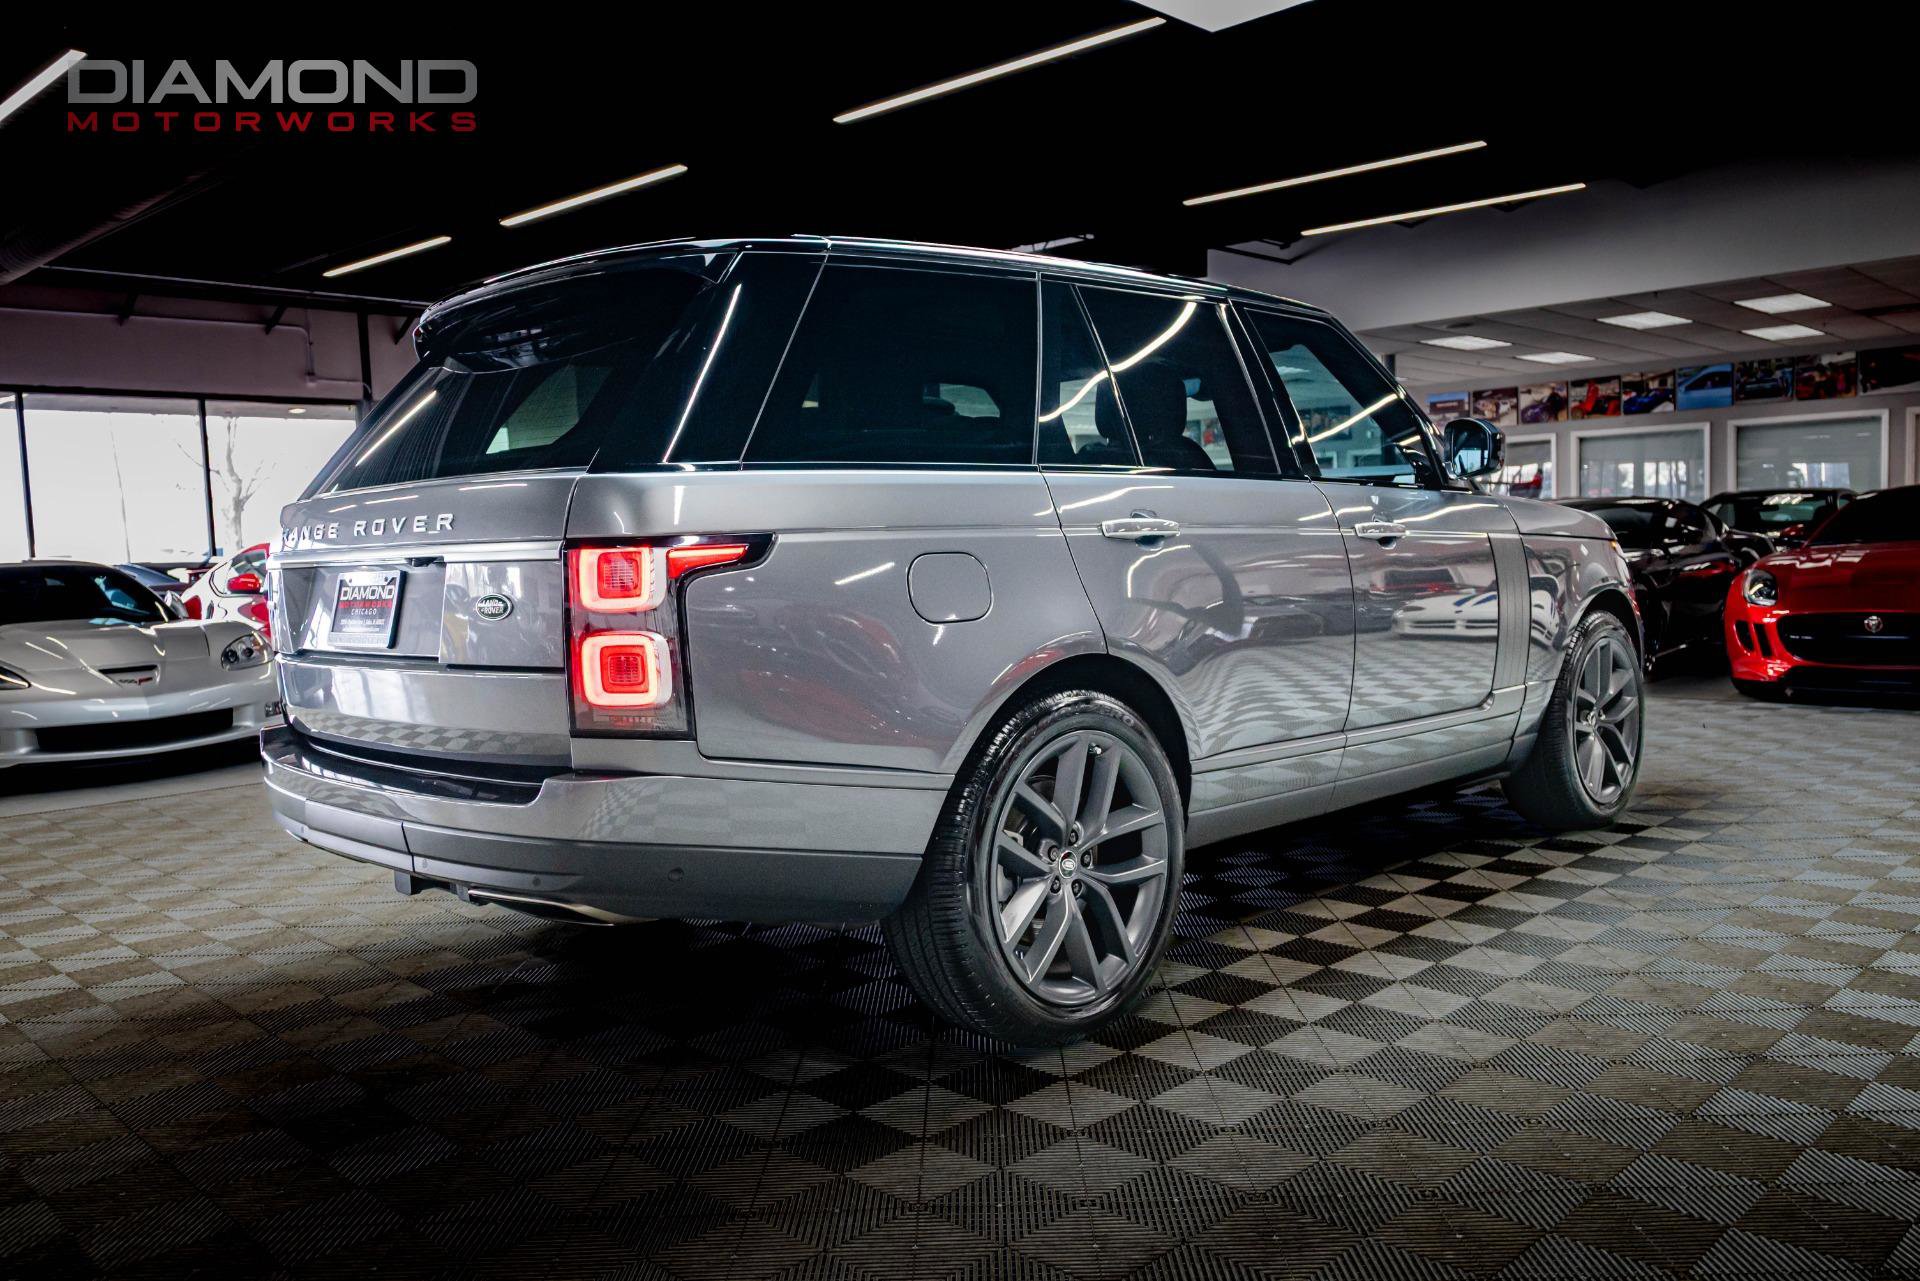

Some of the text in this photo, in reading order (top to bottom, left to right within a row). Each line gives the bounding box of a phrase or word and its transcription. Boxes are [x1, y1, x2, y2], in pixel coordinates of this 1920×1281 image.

[282, 513, 456, 542] RANGE ROVER
[340, 585, 395, 600] DIAMOND
[484, 606, 504, 614] ROVER
